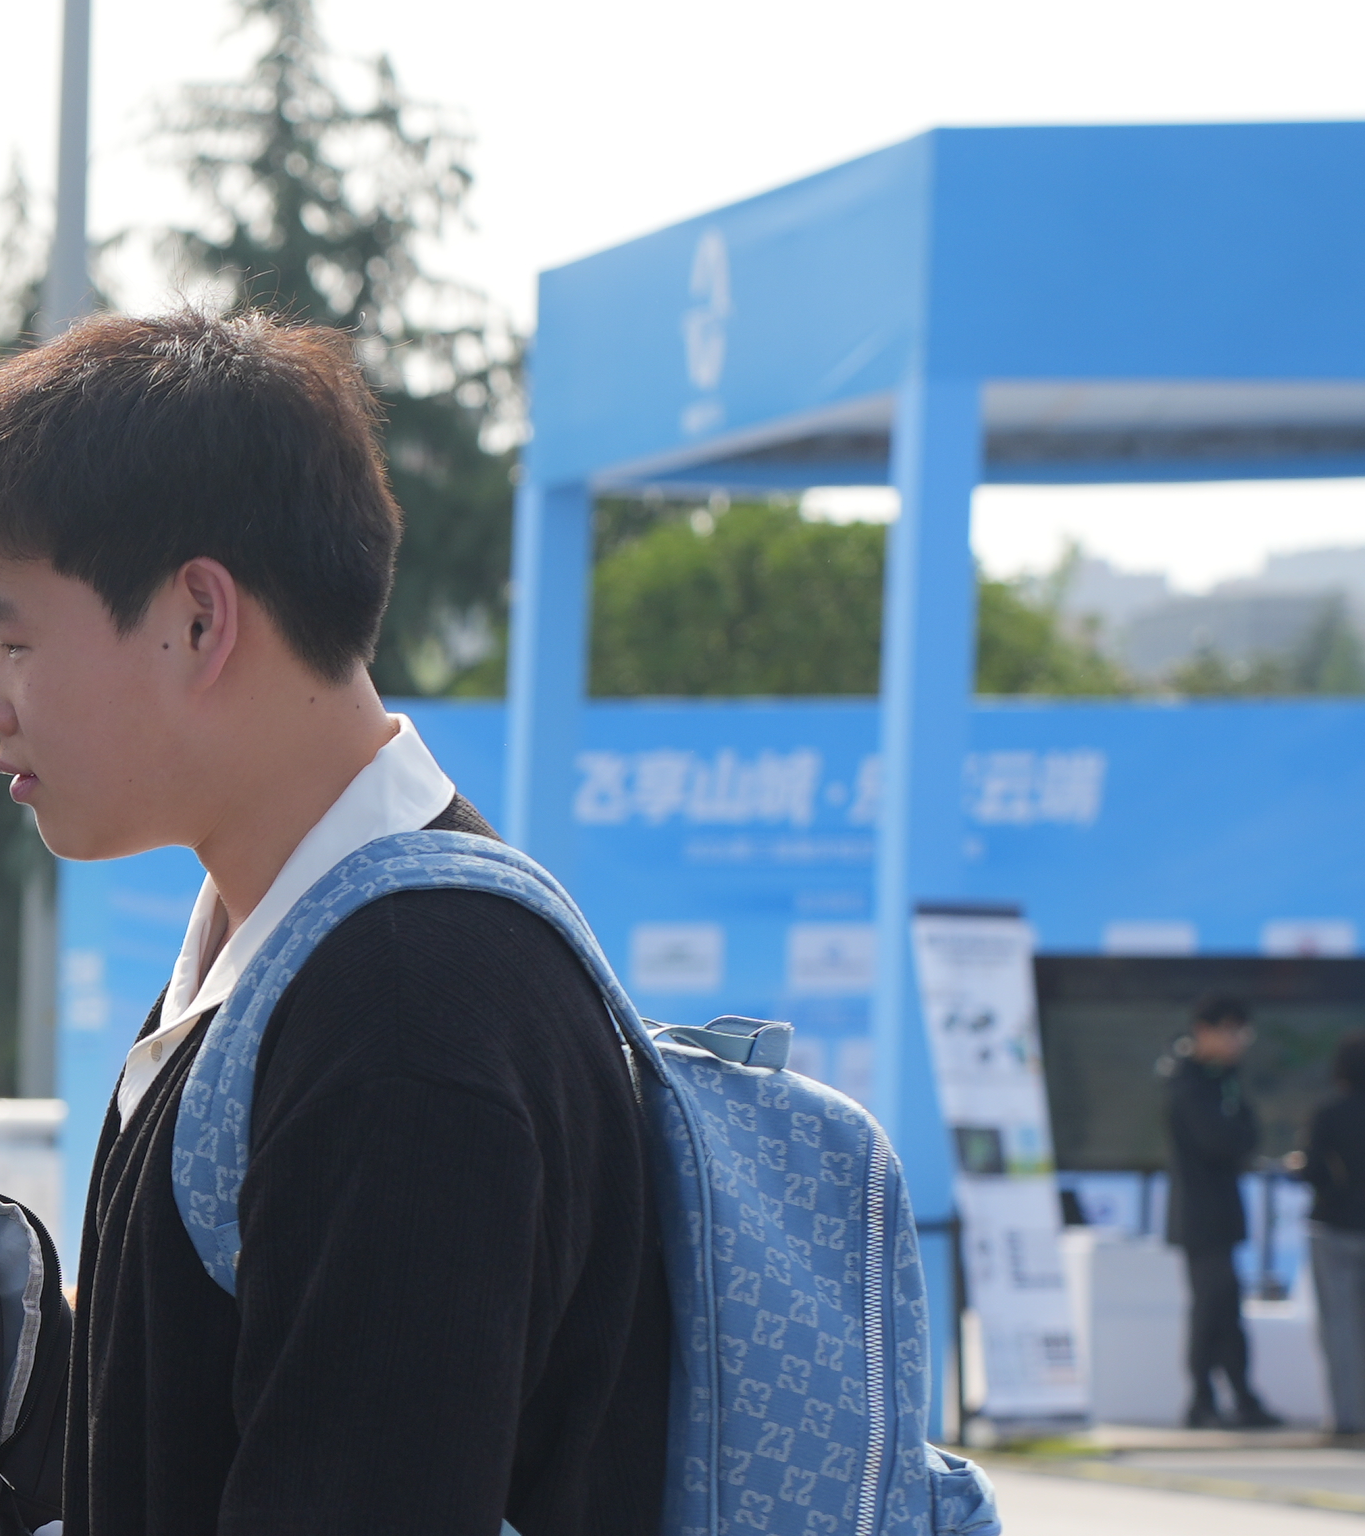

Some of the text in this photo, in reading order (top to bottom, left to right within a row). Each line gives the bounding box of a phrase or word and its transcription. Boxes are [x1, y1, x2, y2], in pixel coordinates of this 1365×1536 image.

[360, 873, 401, 898] 23
[757, 1078, 790, 1110] 23
[726, 1099, 757, 1132] 23
[790, 1111, 820, 1148] 23
[758, 1135, 788, 1172] 23
[820, 1151, 855, 1187] 23
[188, 1190, 218, 1230] 23
[783, 1172, 818, 1211] 23
[813, 1212, 847, 1250] 23
[727, 1265, 762, 1307] 23
[789, 1289, 818, 1328] 23
[752, 1309, 789, 1350] 23
[815, 1331, 844, 1372] 23
[776, 1353, 812, 1395] 23
[733, 1377, 772, 1419] 23
[800, 1398, 836, 1439] 23
[755, 1421, 796, 1463] 23
[820, 1441, 858, 1482] 23
[779, 1465, 818, 1507] 23
[734, 1489, 775, 1531] 23
